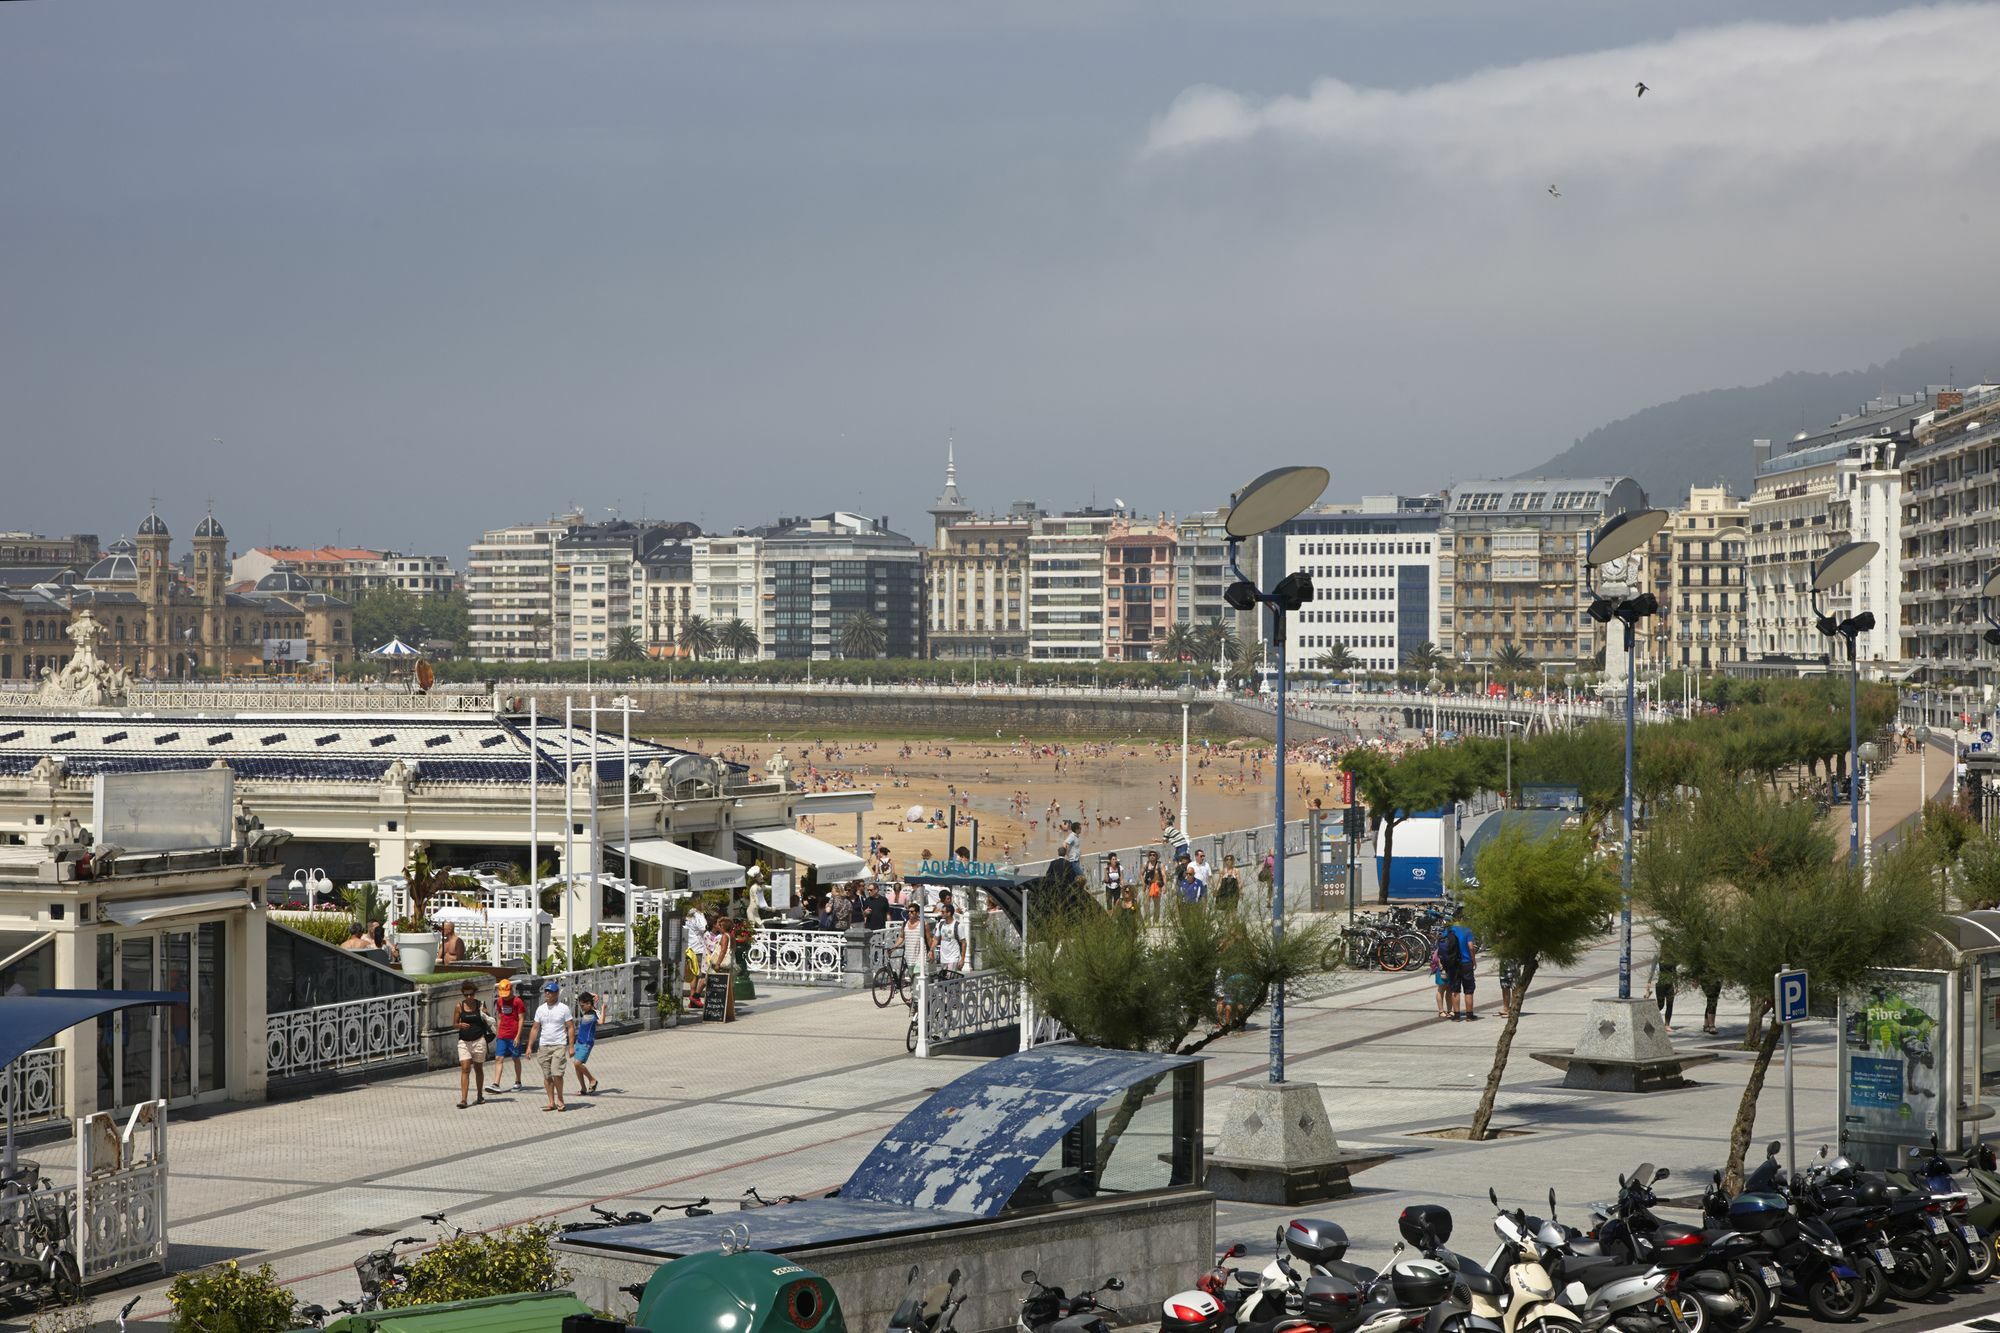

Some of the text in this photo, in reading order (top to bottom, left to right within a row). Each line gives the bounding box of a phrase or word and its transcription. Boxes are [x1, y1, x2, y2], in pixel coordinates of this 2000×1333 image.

[1785, 981, 1801, 1015] P
[1867, 1008, 1902, 1021] Fibra
[1877, 1091, 1887, 1101] 54
